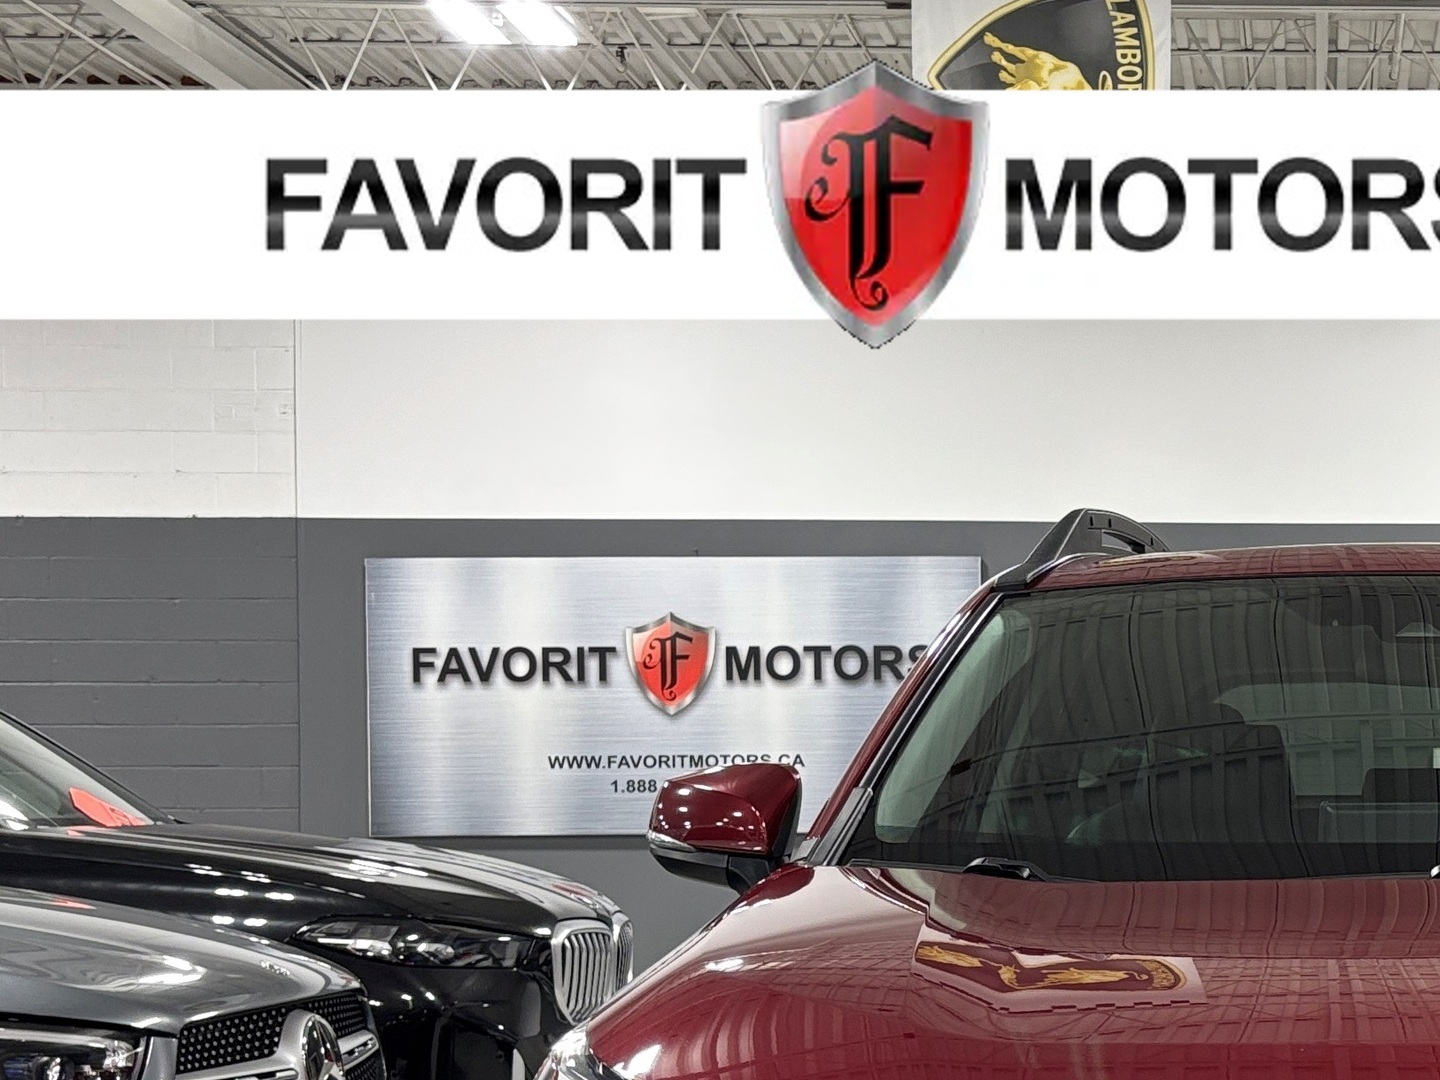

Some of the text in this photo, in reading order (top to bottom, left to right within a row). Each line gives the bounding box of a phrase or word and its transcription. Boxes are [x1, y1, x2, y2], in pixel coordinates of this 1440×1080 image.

[1104, 0, 1143, 90] LAMBO
[411, 646, 617, 683] FAVORIT
[548, 754, 805, 769] WWW.FAVORITMOTORSCA
